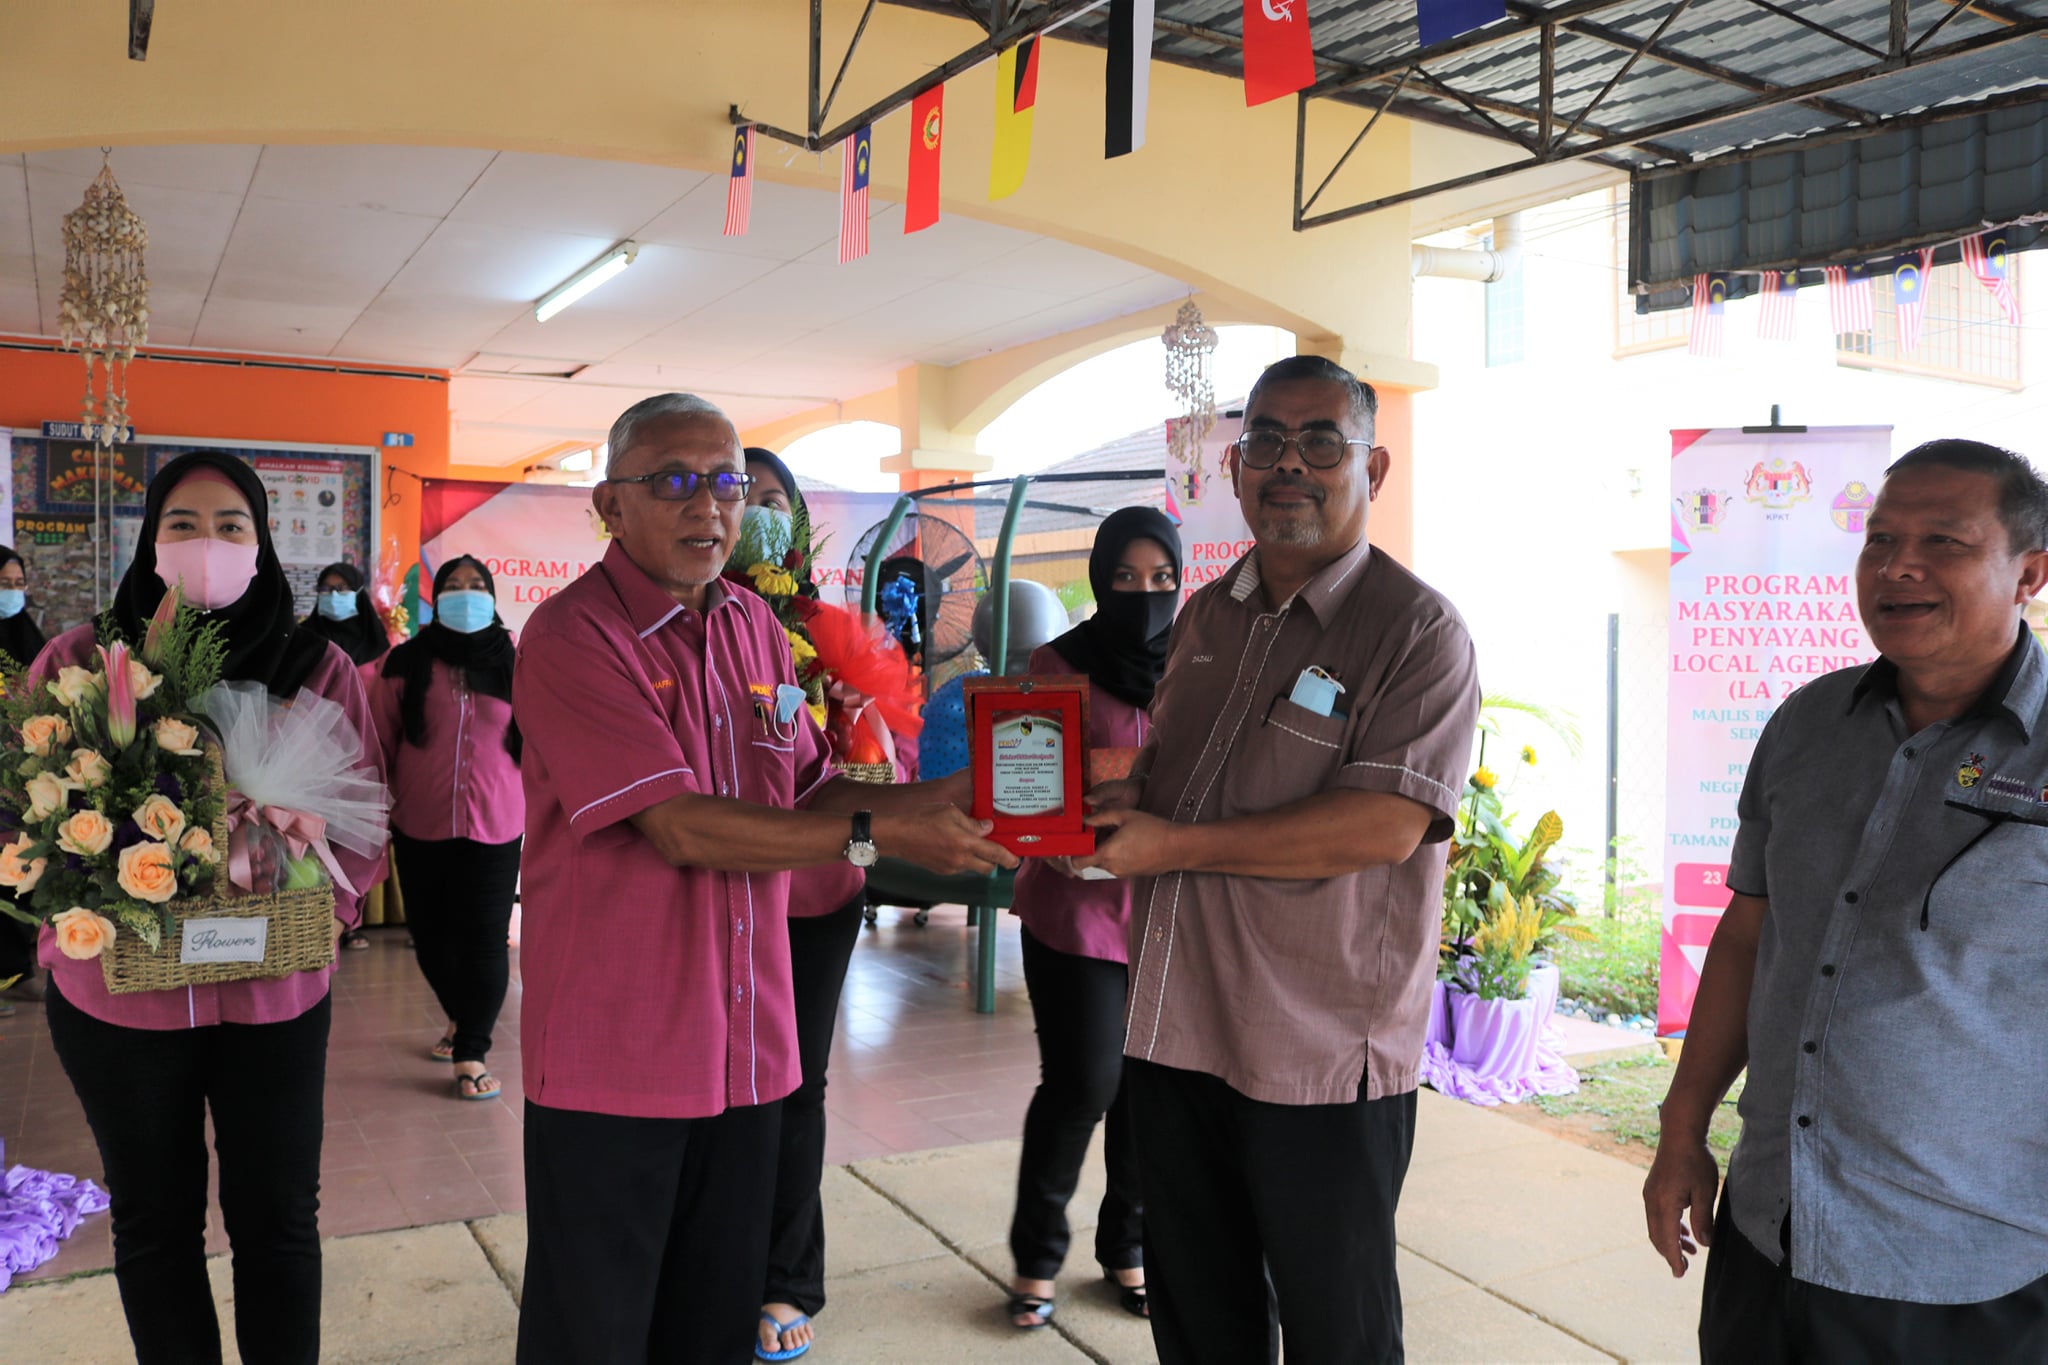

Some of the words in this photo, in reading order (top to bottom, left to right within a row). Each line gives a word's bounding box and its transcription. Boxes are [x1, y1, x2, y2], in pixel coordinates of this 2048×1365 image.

[49, 422, 79, 437] SUDUT
[1765, 513, 1790, 521] KPKT
[15, 519, 86, 533] PROGRAM
[1704, 575, 1849, 596] PROGRAM
[1692, 627, 1860, 649] PENYAYANG
[1673, 654, 1759, 674] LOCAL
[1729, 680, 1771, 701] (LA
[1692, 709, 1750, 723] MAJLIS
[1669, 833, 1730, 848] TAMAN
[1702, 870, 1722, 885] 23
[191, 929, 256, 952] Flowers
